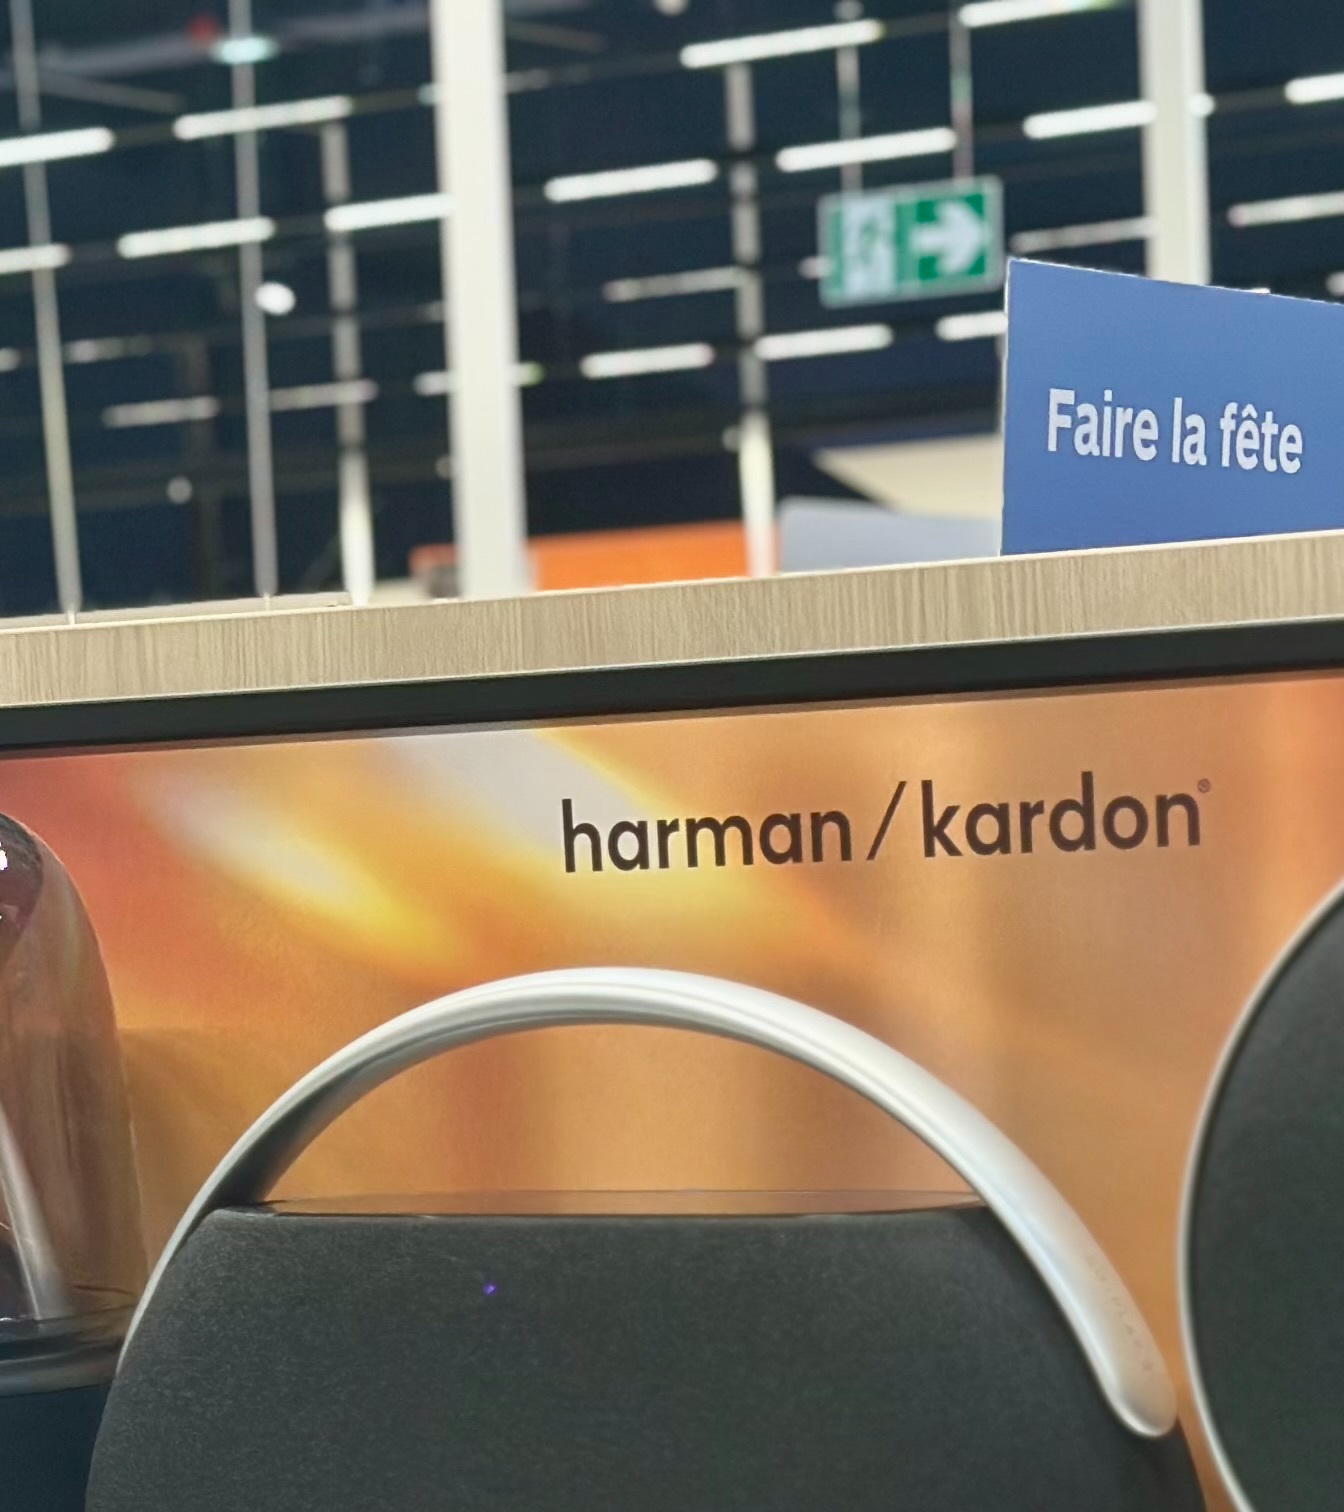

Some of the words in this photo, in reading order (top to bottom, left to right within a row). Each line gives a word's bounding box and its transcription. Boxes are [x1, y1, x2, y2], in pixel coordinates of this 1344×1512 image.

[1048, 388, 1158, 461] Faire
[1171, 397, 1207, 466] la
[1219, 402, 1303, 474] fête
